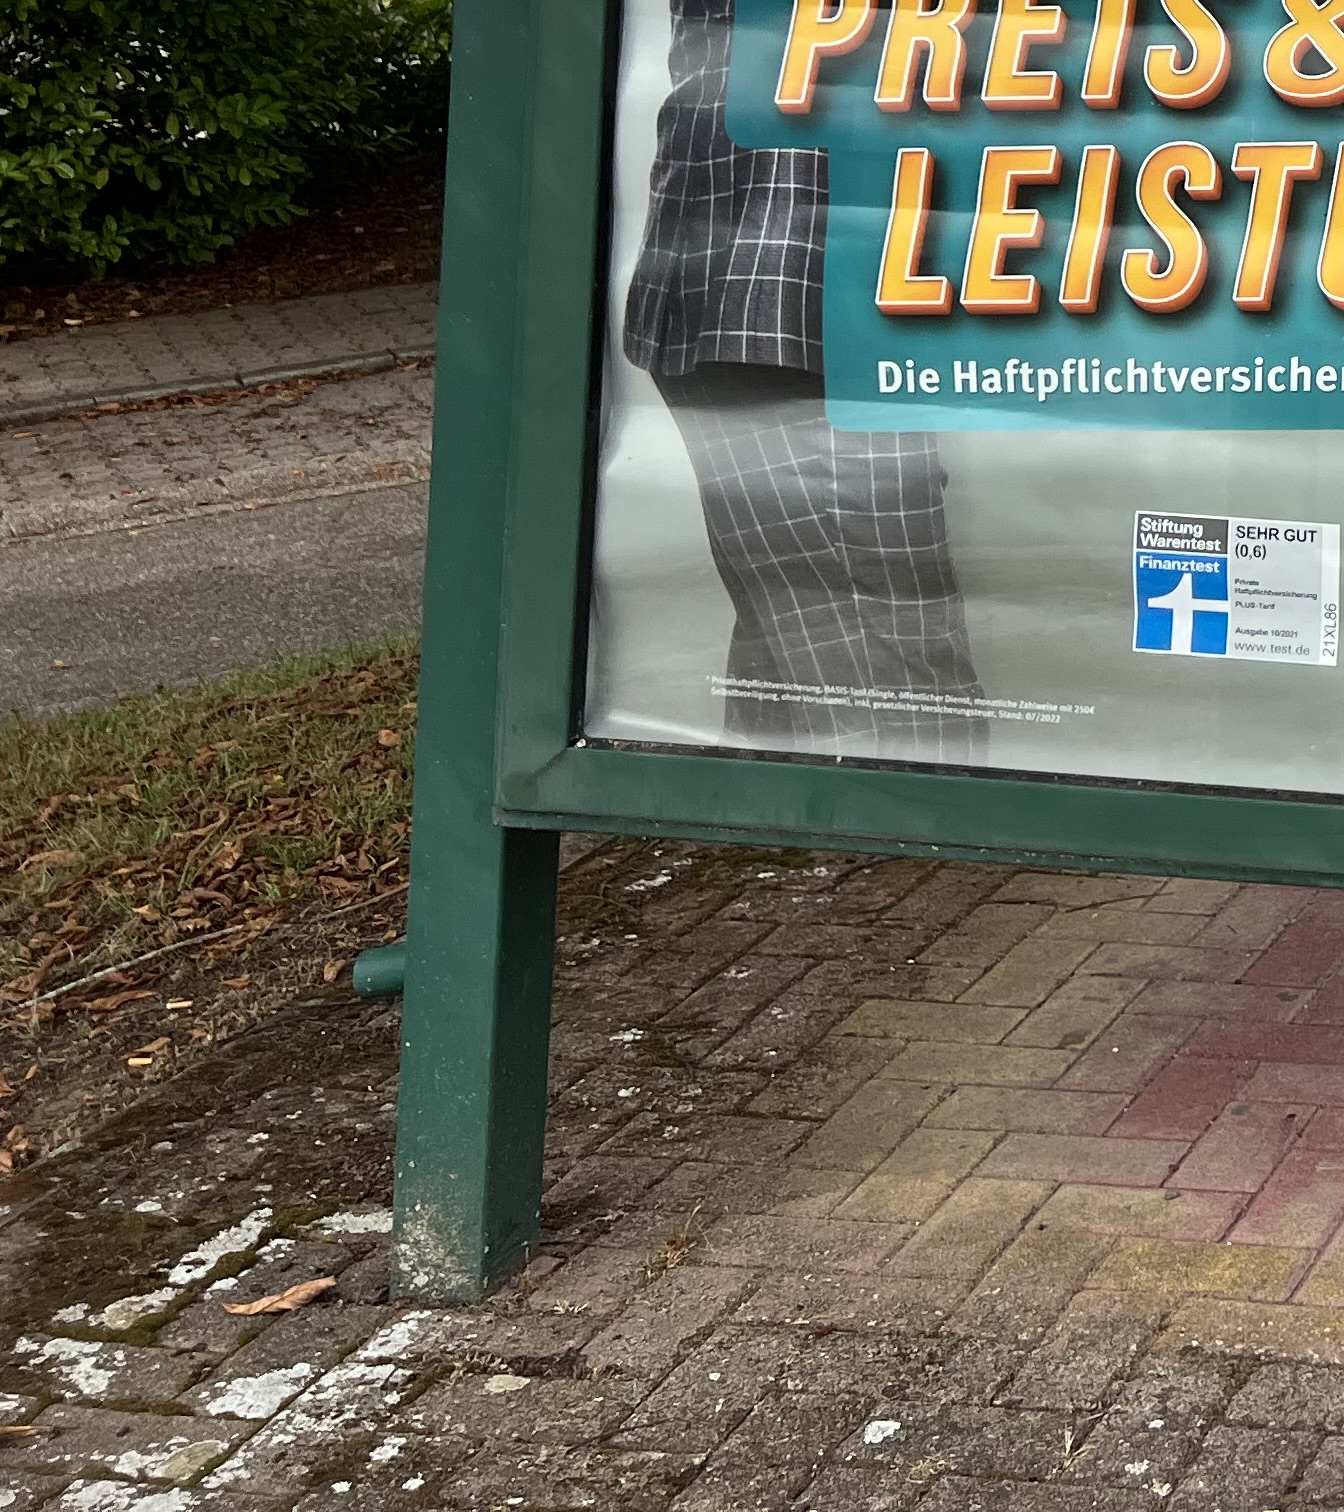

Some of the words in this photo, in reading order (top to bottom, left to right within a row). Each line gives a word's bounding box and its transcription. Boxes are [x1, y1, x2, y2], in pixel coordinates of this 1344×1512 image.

[877, 359, 941, 394] Die
[1140, 516, 1204, 538] Stiftung
[1235, 525, 1280, 542] SEHR
[1283, 528, 1317, 543] GUT
[1139, 532, 1222, 552] Warentest
[1234, 543, 1267, 561] (0,6)
[1139, 555, 1220, 574] Finanztest
[1234, 587, 1318, 600] Haftpflichtversicherung
[1234, 626, 1269, 637] Ausgabe
[1270, 629, 1298, 638] 10/2021
[1322, 603, 1337, 657] 21XL86
[1234, 642, 1310, 656] www.test.de
[1025, 711, 1061, 724] 07/2022
[1060, 704, 1073, 713] mit
[1074, 704, 1096, 715] 250€
